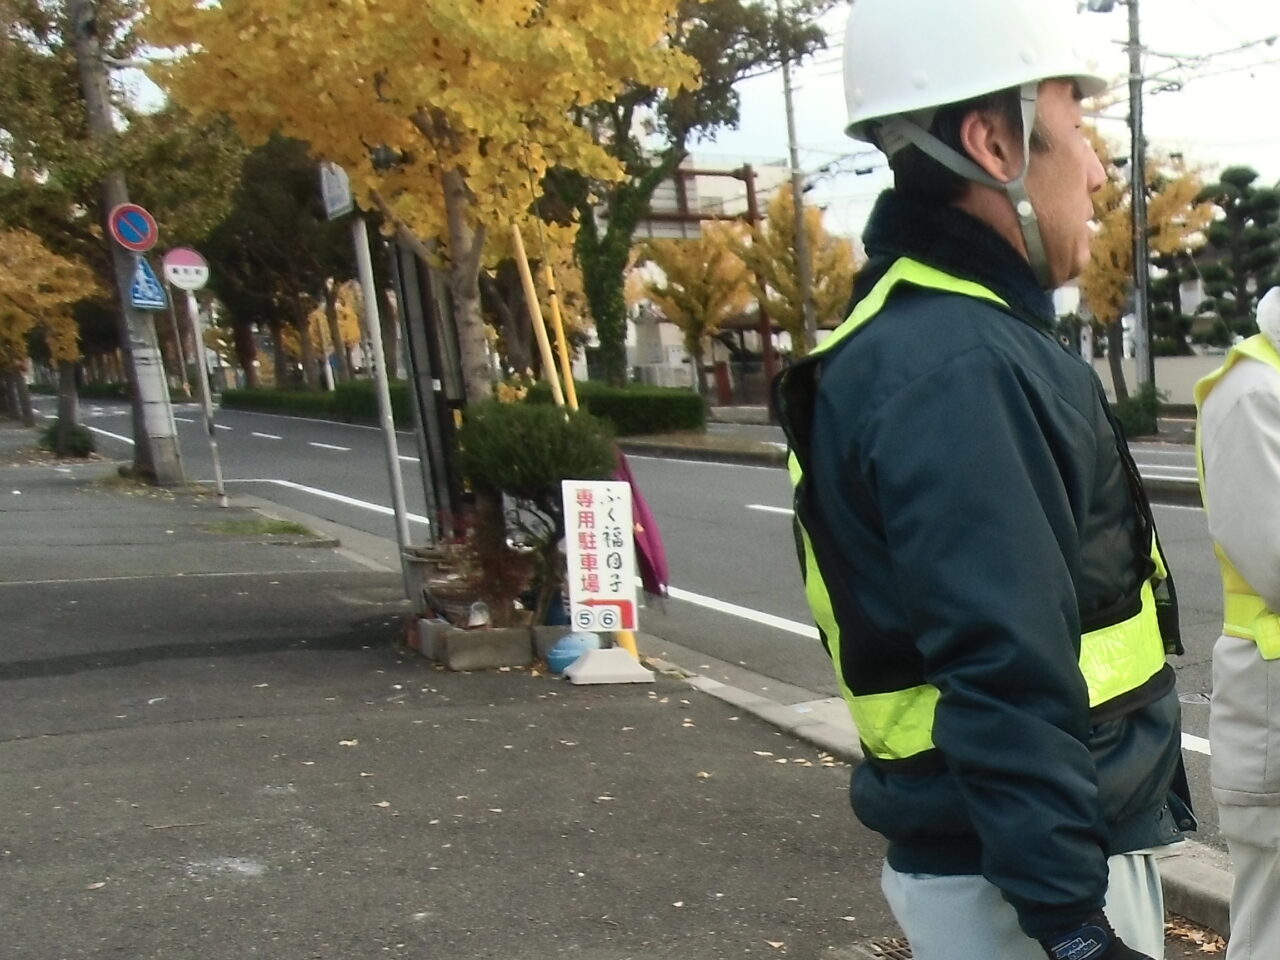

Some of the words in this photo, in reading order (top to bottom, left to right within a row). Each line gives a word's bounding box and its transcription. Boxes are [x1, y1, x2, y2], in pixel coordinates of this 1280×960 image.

[575, 488, 600, 594] 専用駐車場
